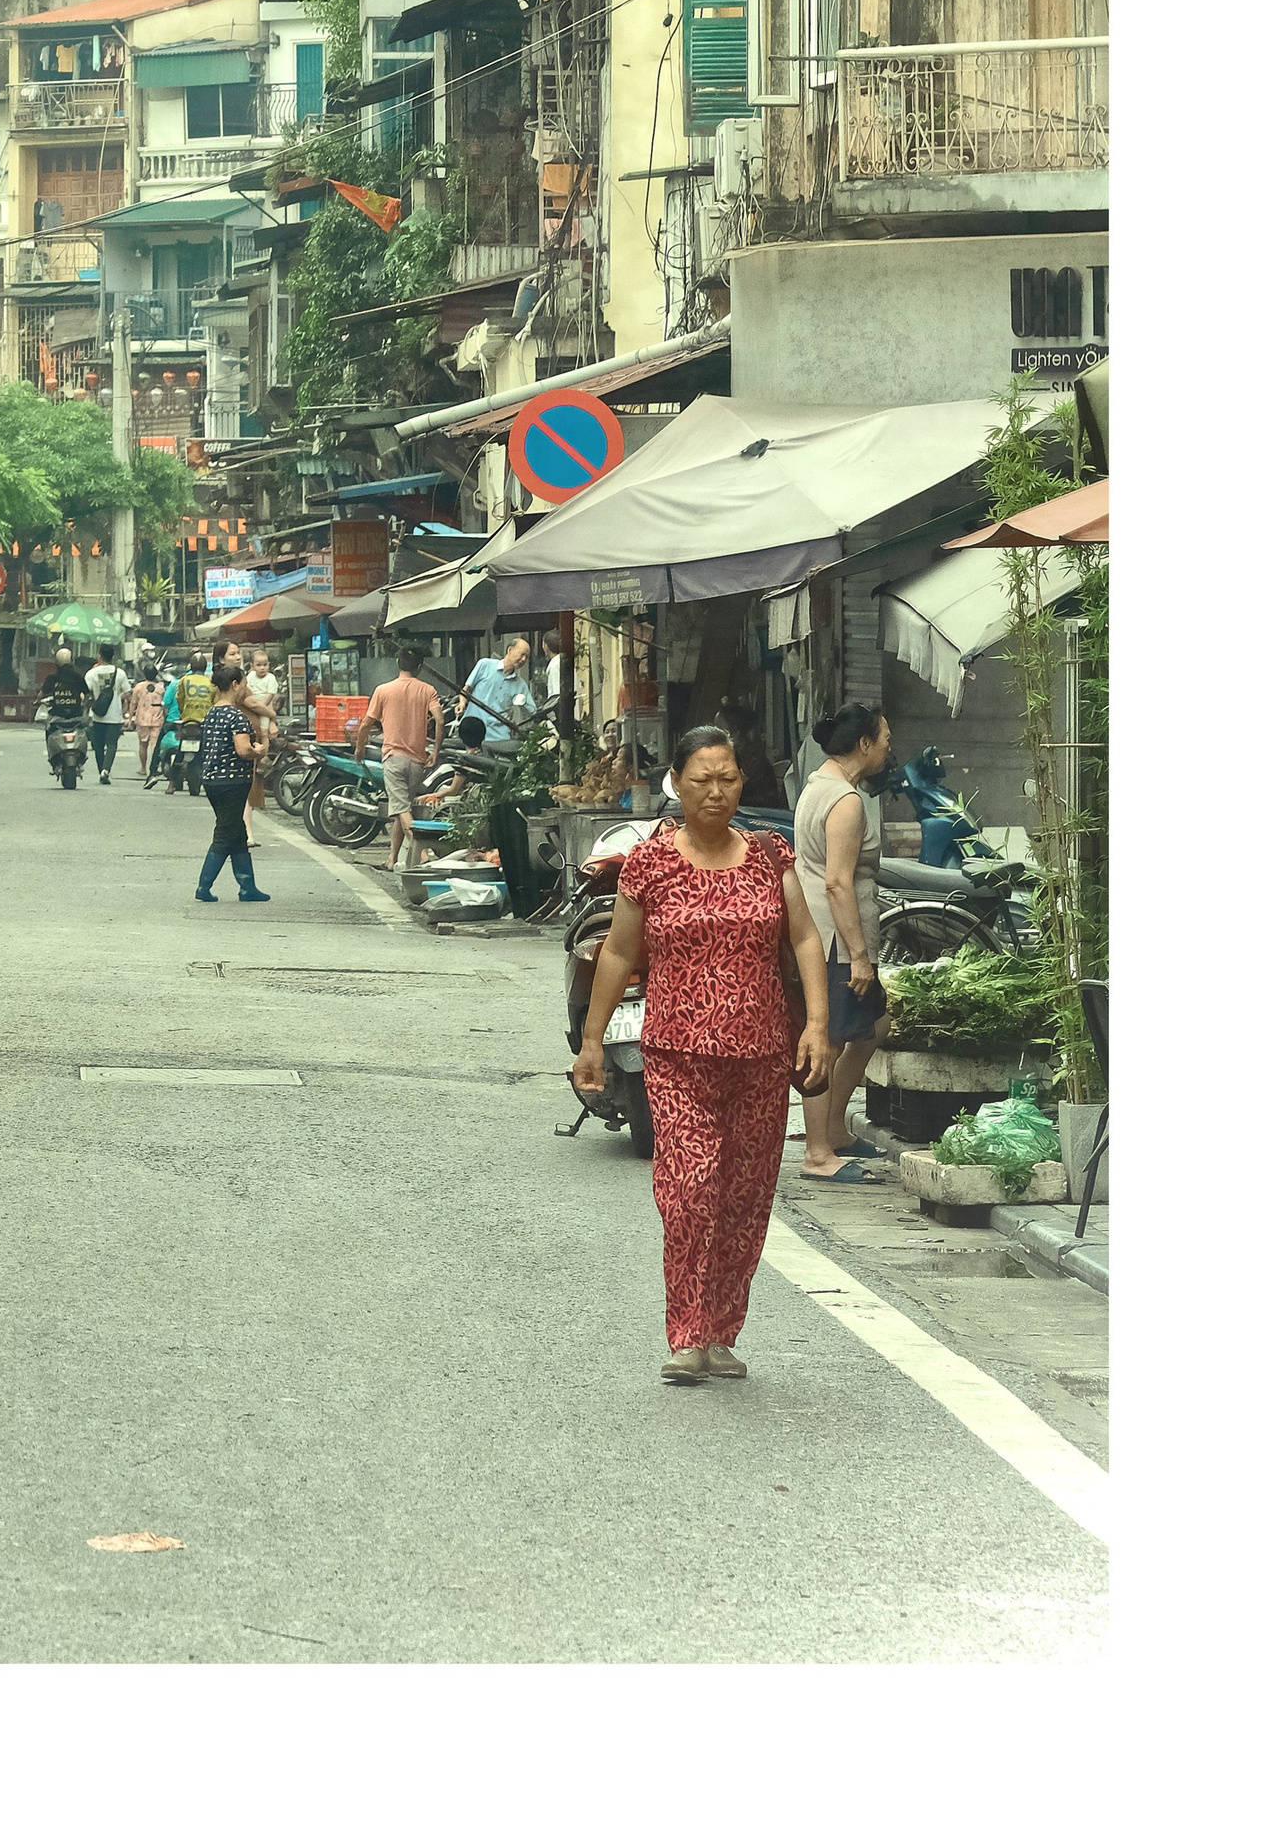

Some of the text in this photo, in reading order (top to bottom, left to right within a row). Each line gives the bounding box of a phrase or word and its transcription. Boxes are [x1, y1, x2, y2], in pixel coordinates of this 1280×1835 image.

[1017, 351, 1071, 369] Lighten
[186, 680, 210, 698] be
[612, 1002, 641, 1021] 9-D
[604, 1021, 642, 1041] 970.
